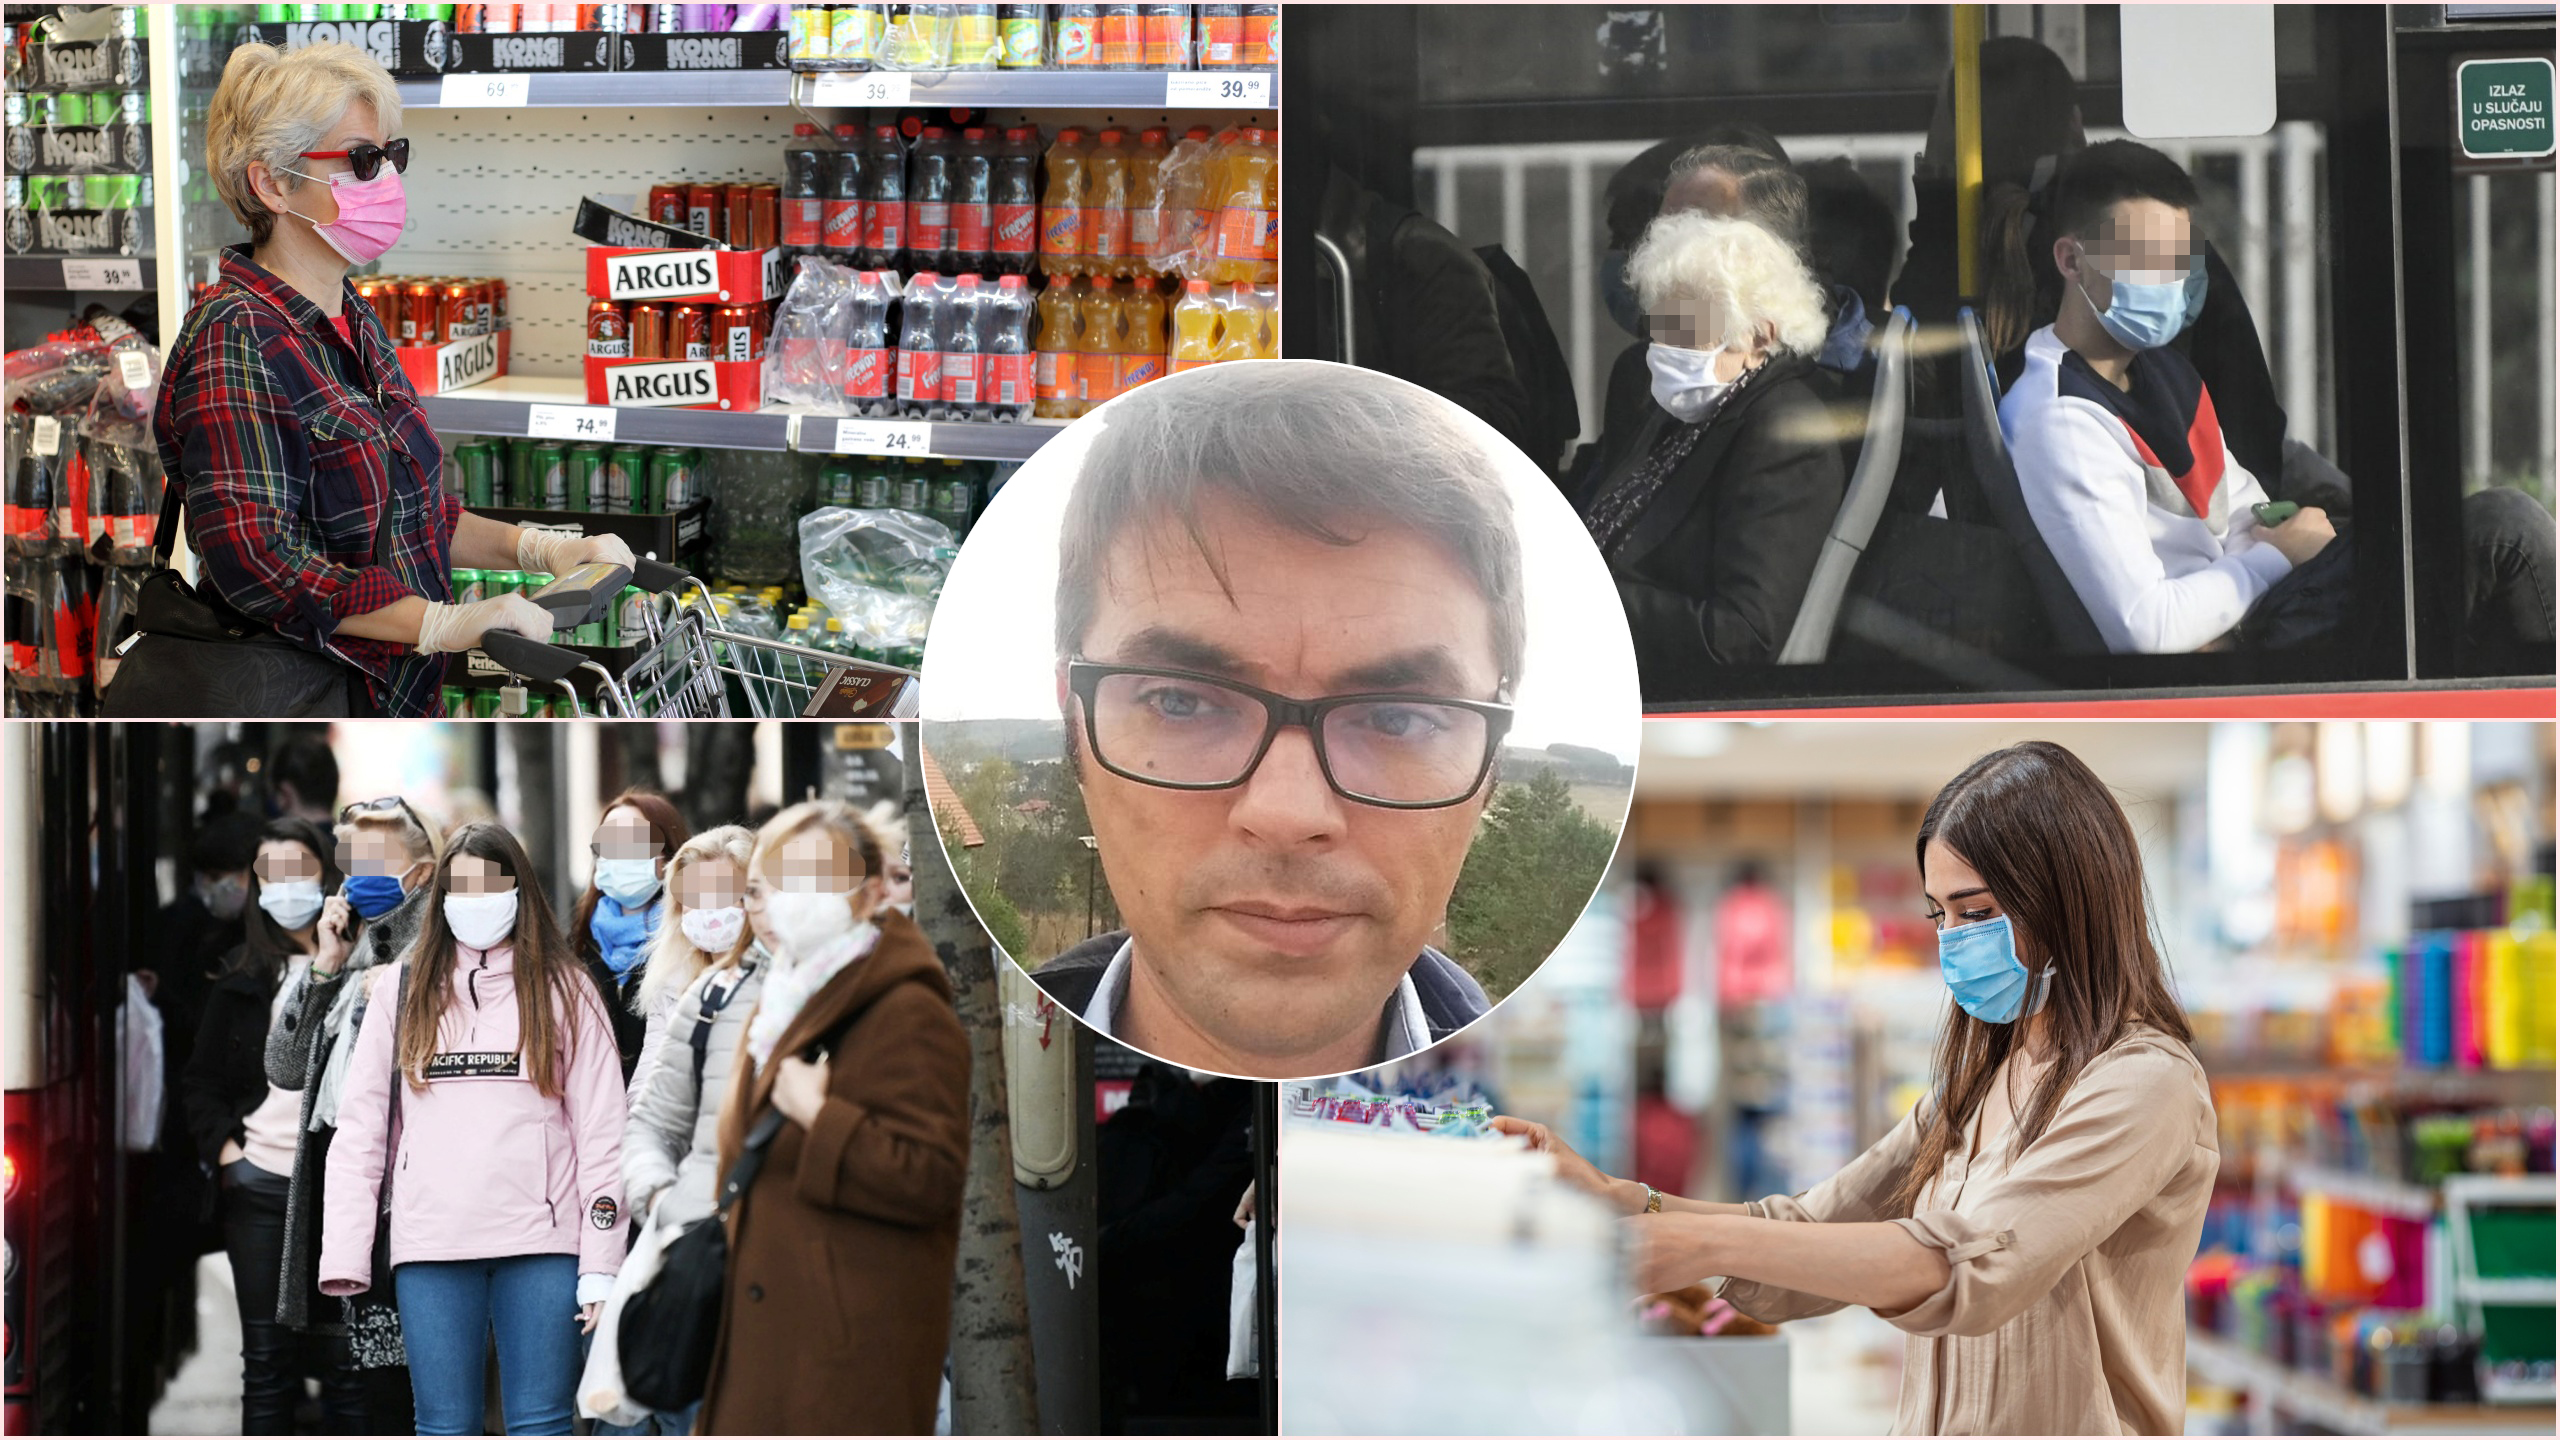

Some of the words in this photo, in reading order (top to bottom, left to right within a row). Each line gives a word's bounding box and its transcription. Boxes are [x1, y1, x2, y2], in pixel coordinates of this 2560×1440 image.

[286, 21, 393, 51] KONG
[493, 37, 559, 56] KONG
[667, 38, 736, 58] KONG
[493, 53, 560, 68] STRONG
[667, 55, 736, 69] STRONG
[2489, 84, 2526, 97] IZLAZ
[2473, 102, 2482, 114] U
[2485, 98, 2542, 114] SLUČAJU
[2471, 117, 2545, 131] OPASNOSTI
[616, 258, 711, 292] ARGUS
[590, 341, 627, 355] ARGUS
[441, 335, 495, 390] ARGUS
[615, 368, 710, 400] ARGUS
[839, 676, 872, 688] CLASSIC
[431, 1054, 465, 1067] ACIFIC
